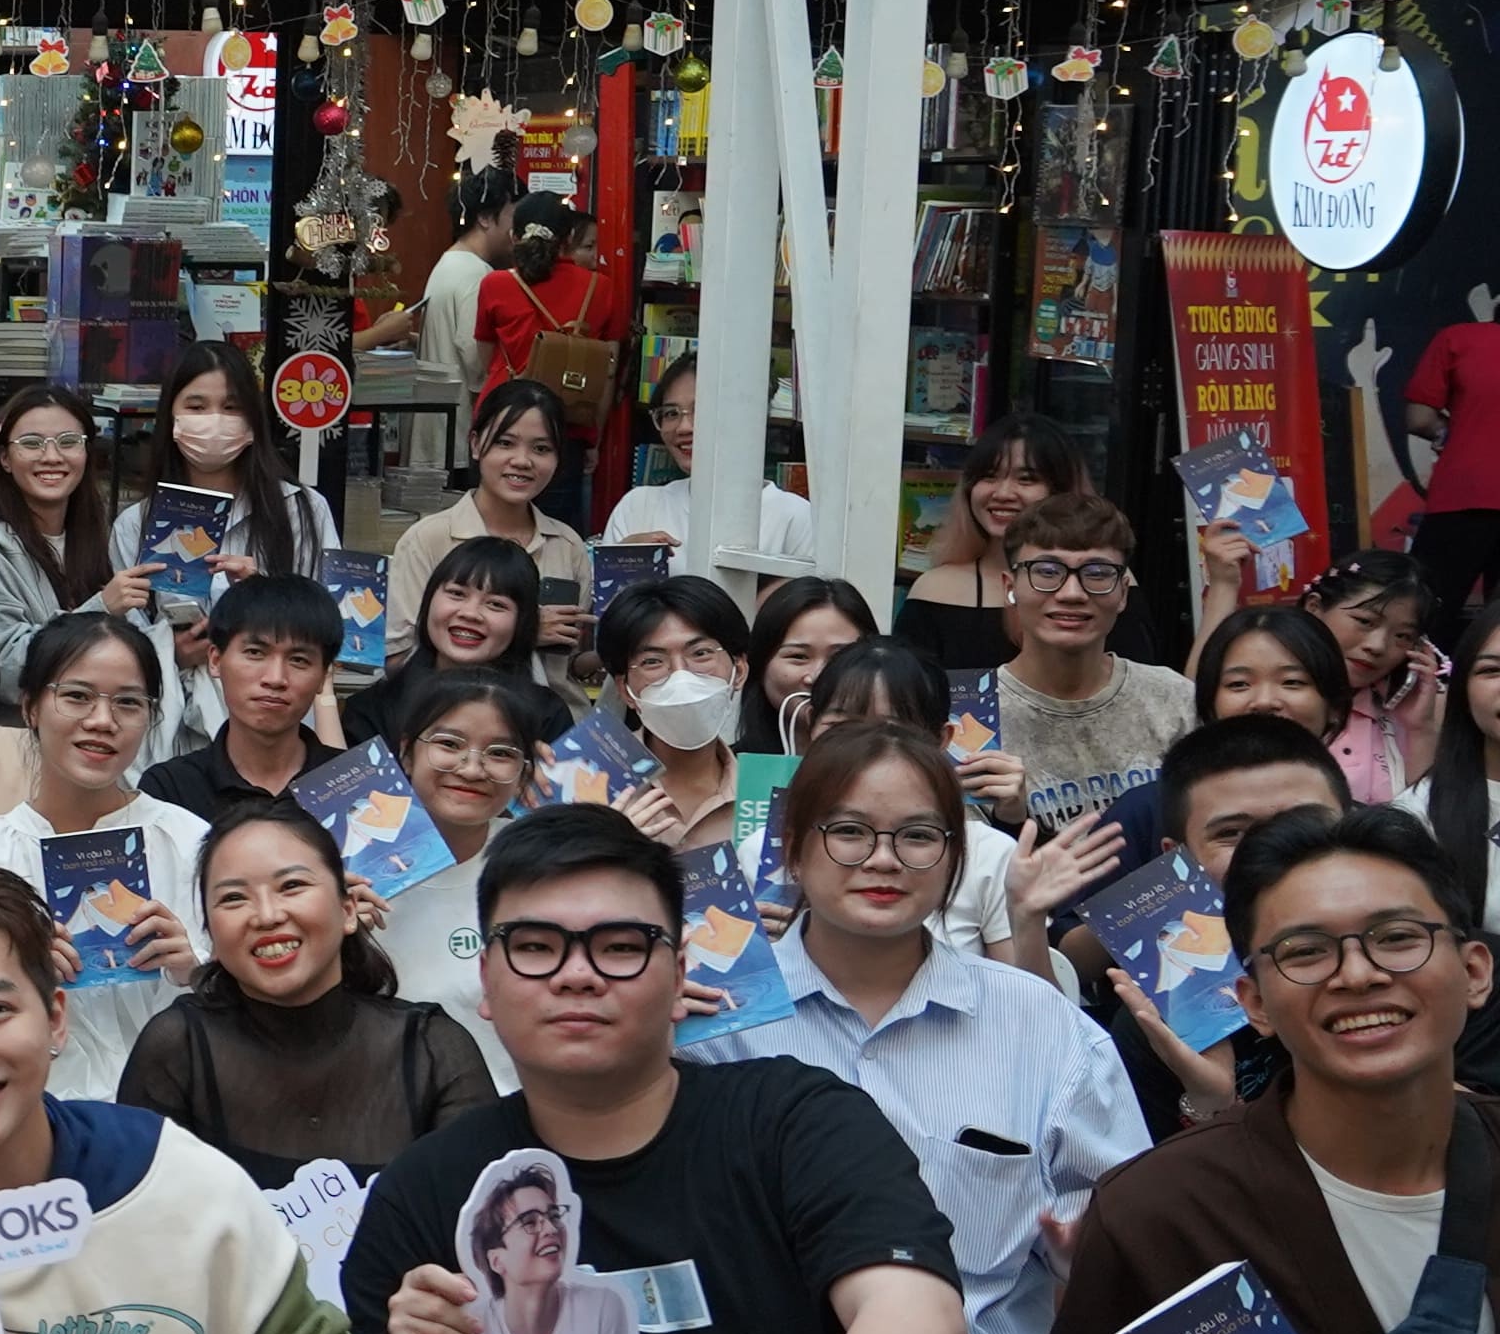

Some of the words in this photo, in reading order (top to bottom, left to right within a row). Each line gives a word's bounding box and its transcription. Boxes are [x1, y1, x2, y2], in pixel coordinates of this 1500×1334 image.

[1293, 182, 1322, 227] KIM
[1327, 181, 1376, 229] ĐỒNG
[1195, 335, 1240, 371] GIÁNG
[1243, 342, 1275, 370] SINH
[279, 378, 344, 403] 30%
[1196, 378, 1230, 417] RỘN
[1233, 378, 1276, 410] RÀNG
[738, 800, 770, 819] SE
[310, 1171, 347, 1204] là
[1215, 1312, 1228, 1326] là
